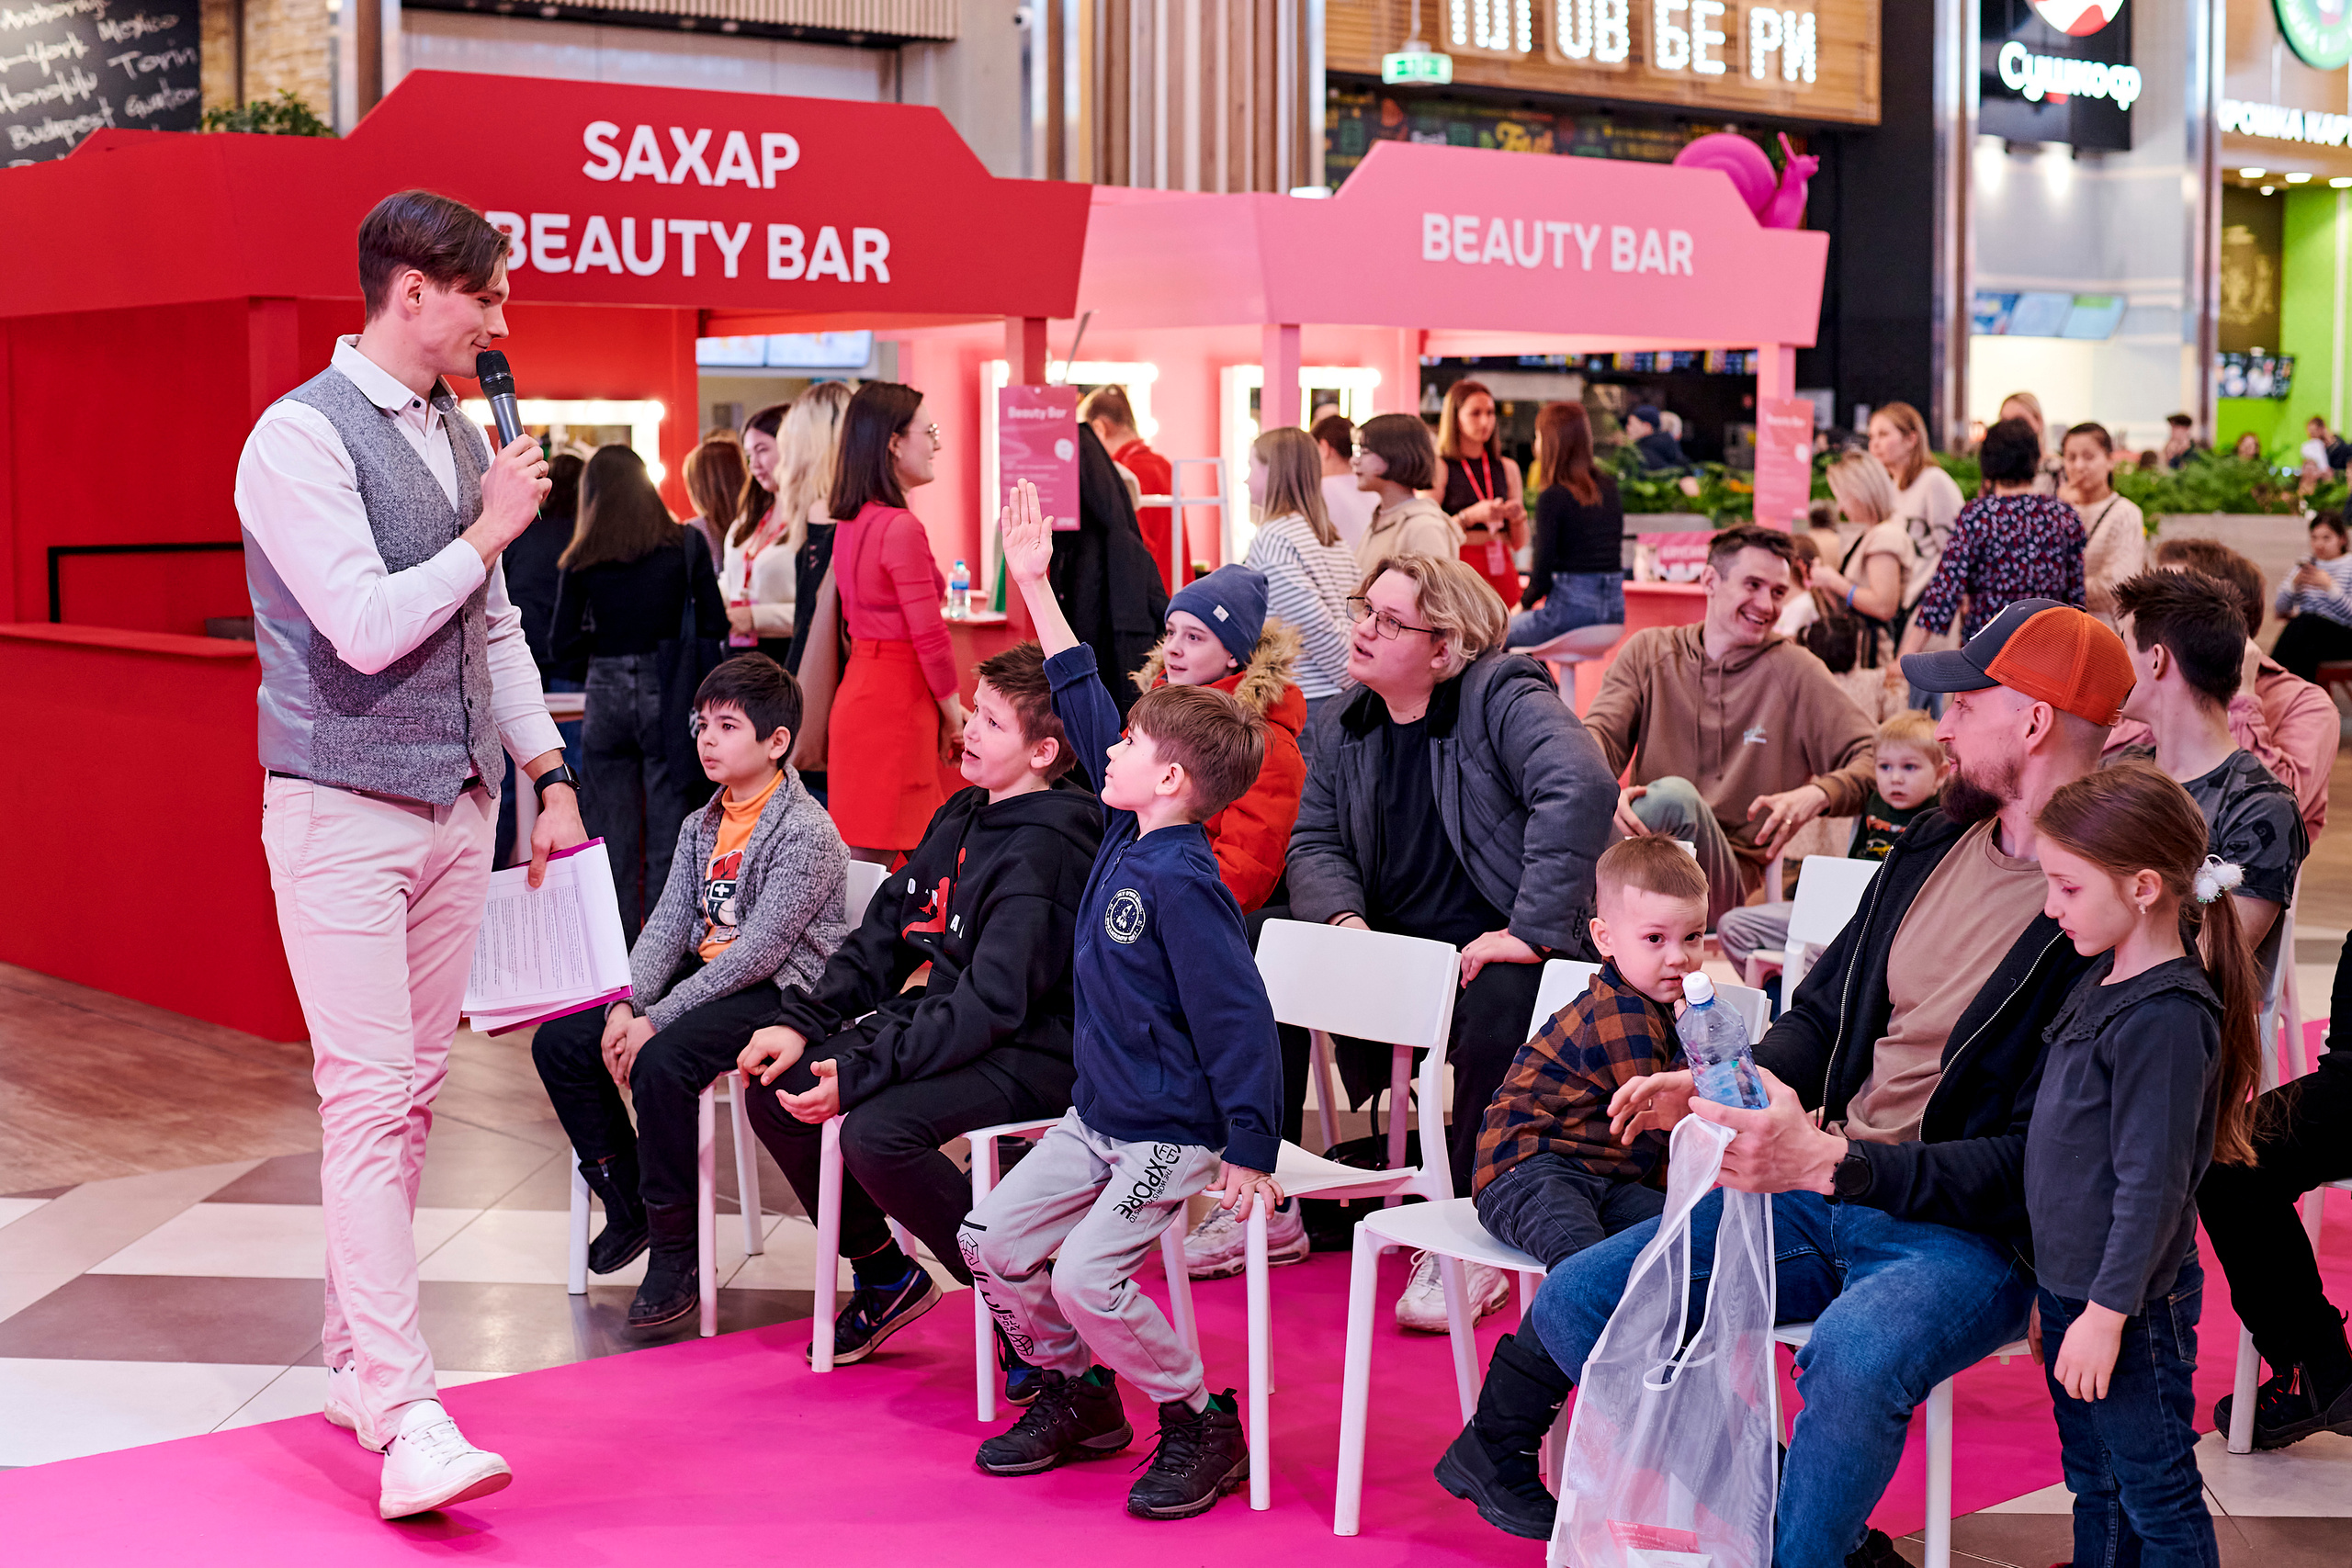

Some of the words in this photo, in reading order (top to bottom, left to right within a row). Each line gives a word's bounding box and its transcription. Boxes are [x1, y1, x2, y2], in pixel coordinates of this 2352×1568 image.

[1998, 40, 2143, 111] Сушкоф
[485, 210, 752, 278] BEAUTY
[767, 222, 891, 283] BAR
[1422, 212, 1602, 271] BEAUTY
[1611, 225, 1694, 276] BAR
